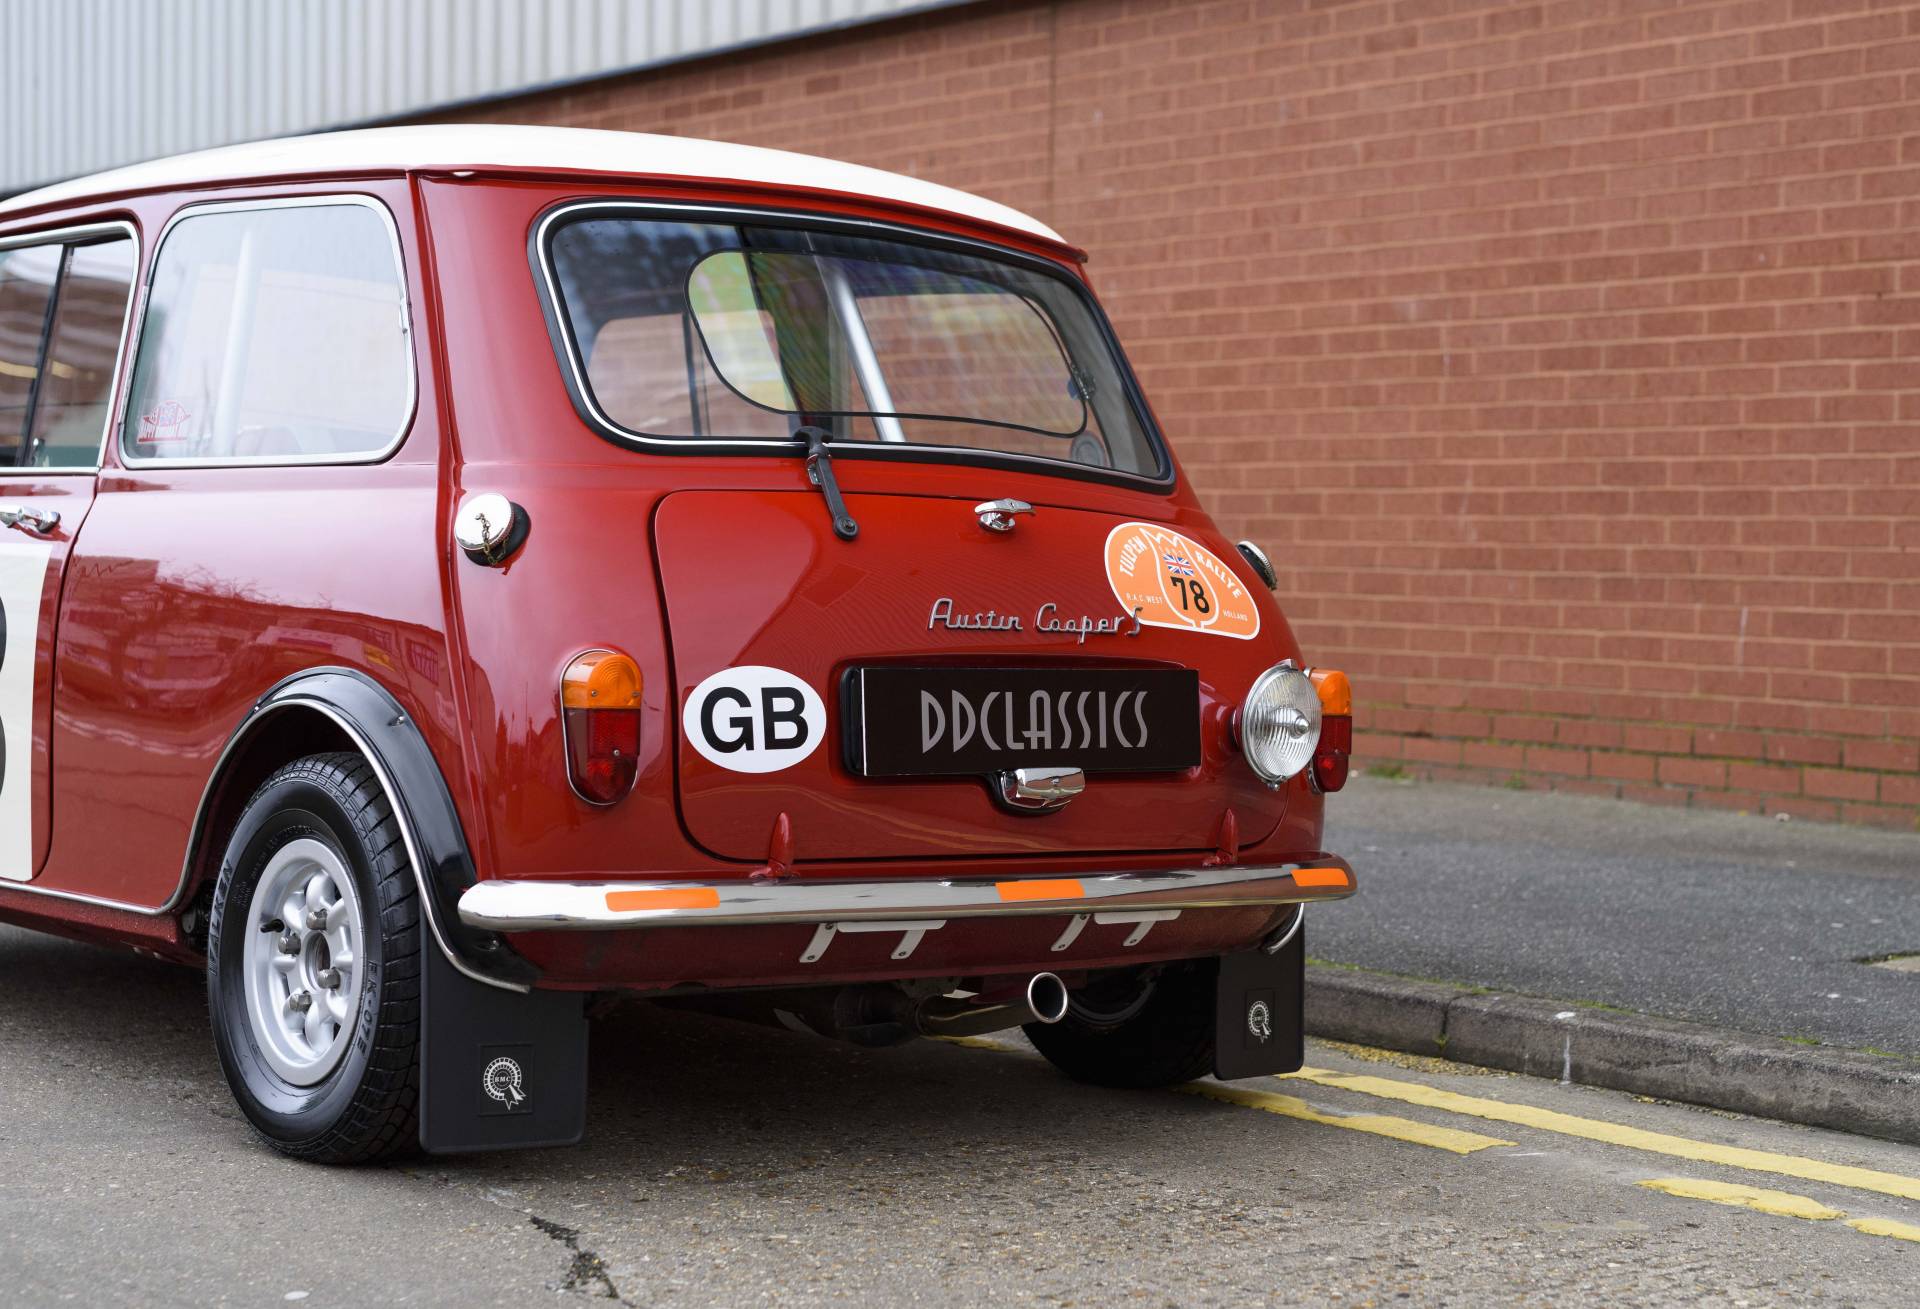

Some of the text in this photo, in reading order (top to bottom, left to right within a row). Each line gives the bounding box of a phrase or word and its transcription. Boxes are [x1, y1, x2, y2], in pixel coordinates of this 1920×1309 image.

[1119, 535, 1148, 577] TULPEN
[1195, 551, 1242, 599] RALLYE
[1146, 595, 1163, 606] WEST
[1170, 577, 1210, 613] 78
[928, 598, 1144, 645] Austin Cooper S
[701, 687, 808, 753] GB
